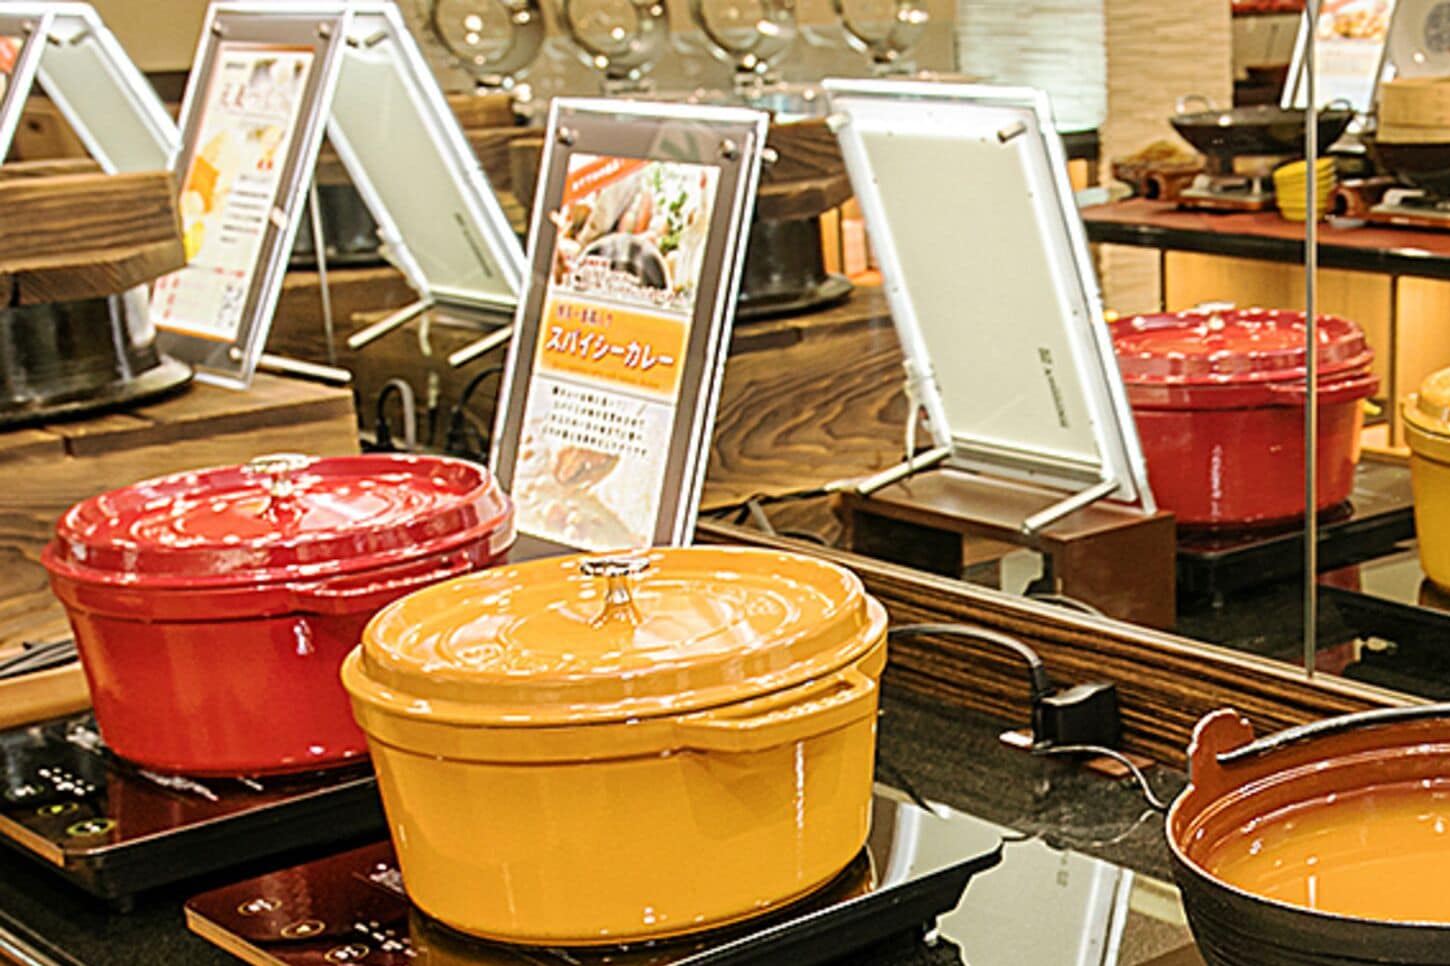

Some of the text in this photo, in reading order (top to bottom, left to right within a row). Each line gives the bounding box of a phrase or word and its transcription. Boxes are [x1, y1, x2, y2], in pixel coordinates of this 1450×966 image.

[546, 326, 674, 371] スパイシーカレー
